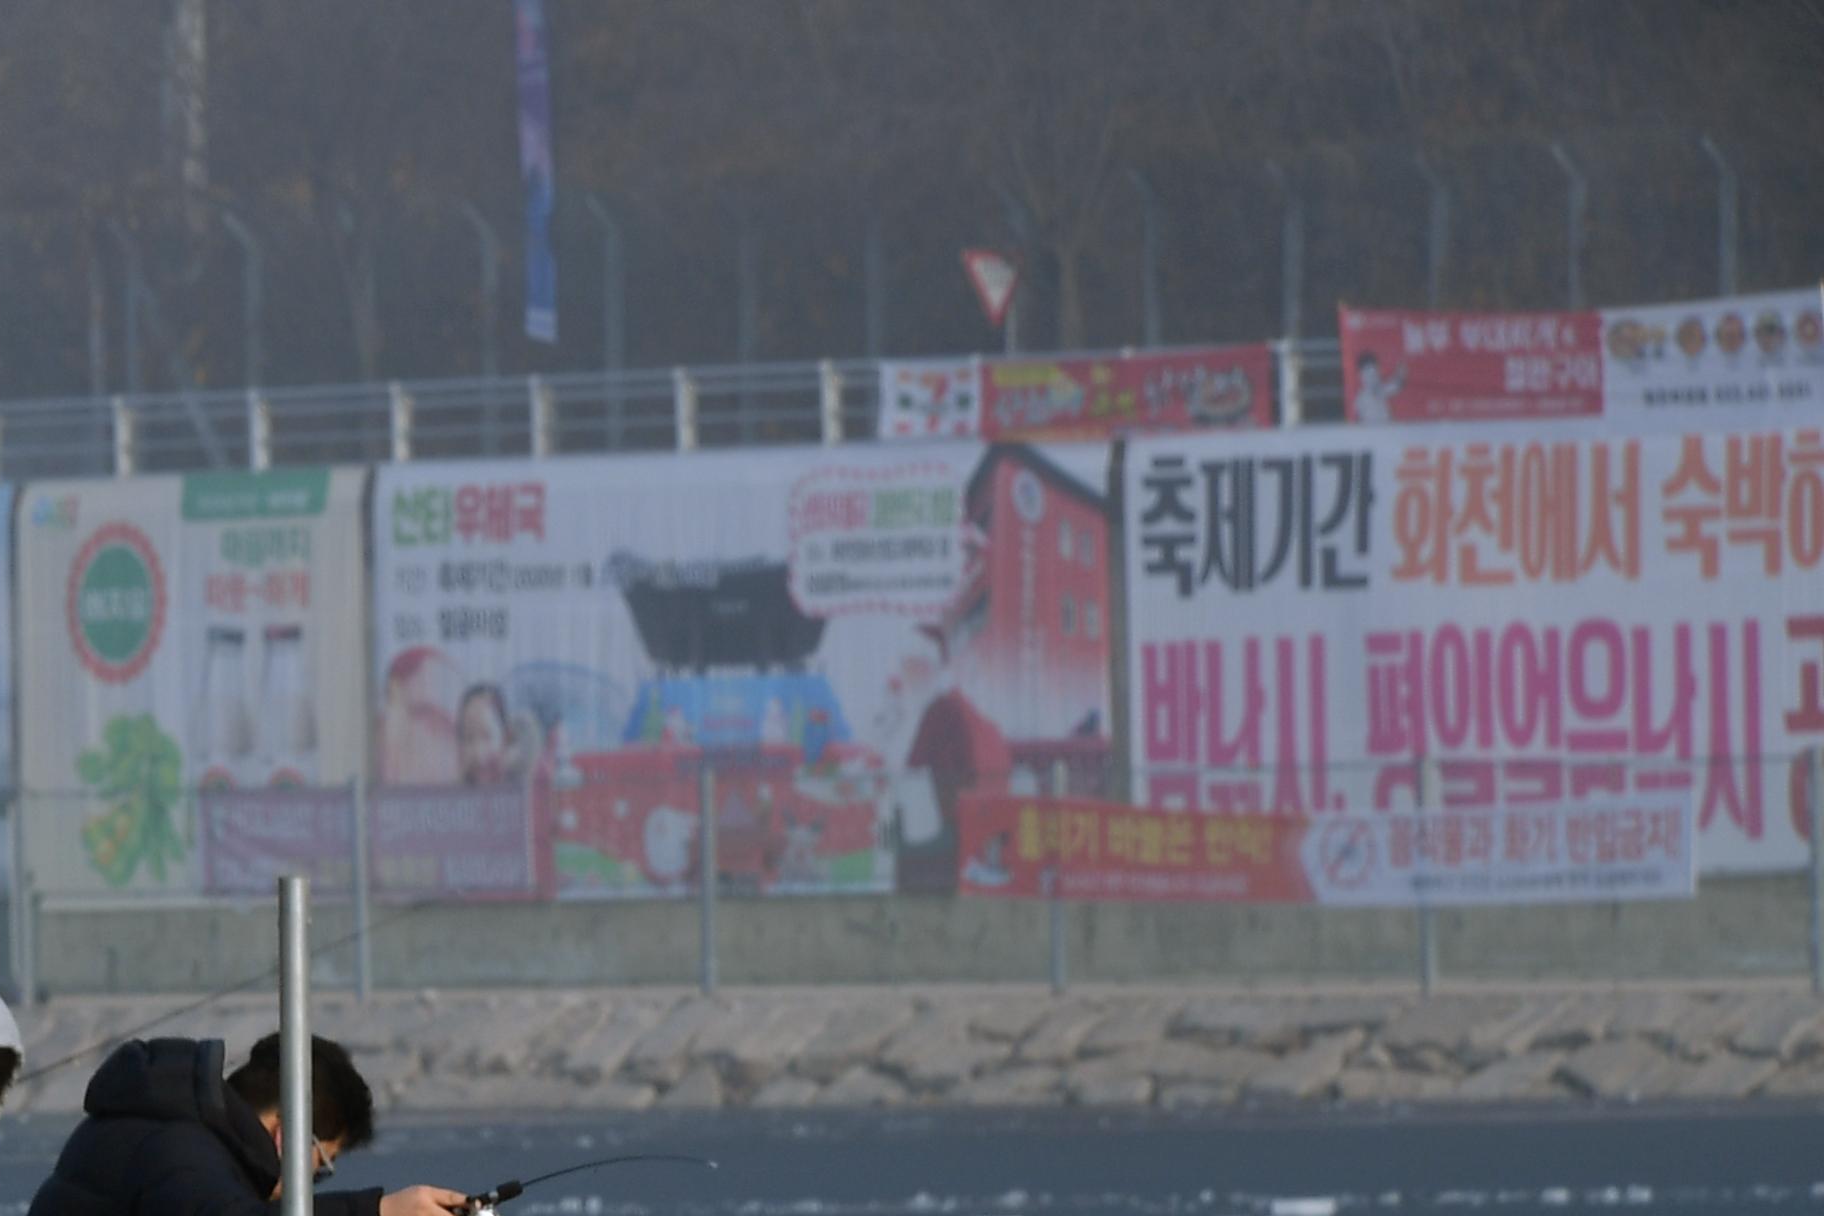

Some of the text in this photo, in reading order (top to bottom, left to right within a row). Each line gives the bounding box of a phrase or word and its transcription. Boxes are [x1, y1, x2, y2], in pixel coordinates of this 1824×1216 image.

[391, 482, 548, 547] 산타우체국
[1140, 451, 1373, 599] 축제기간
[1390, 438, 1642, 587] 화천에서
